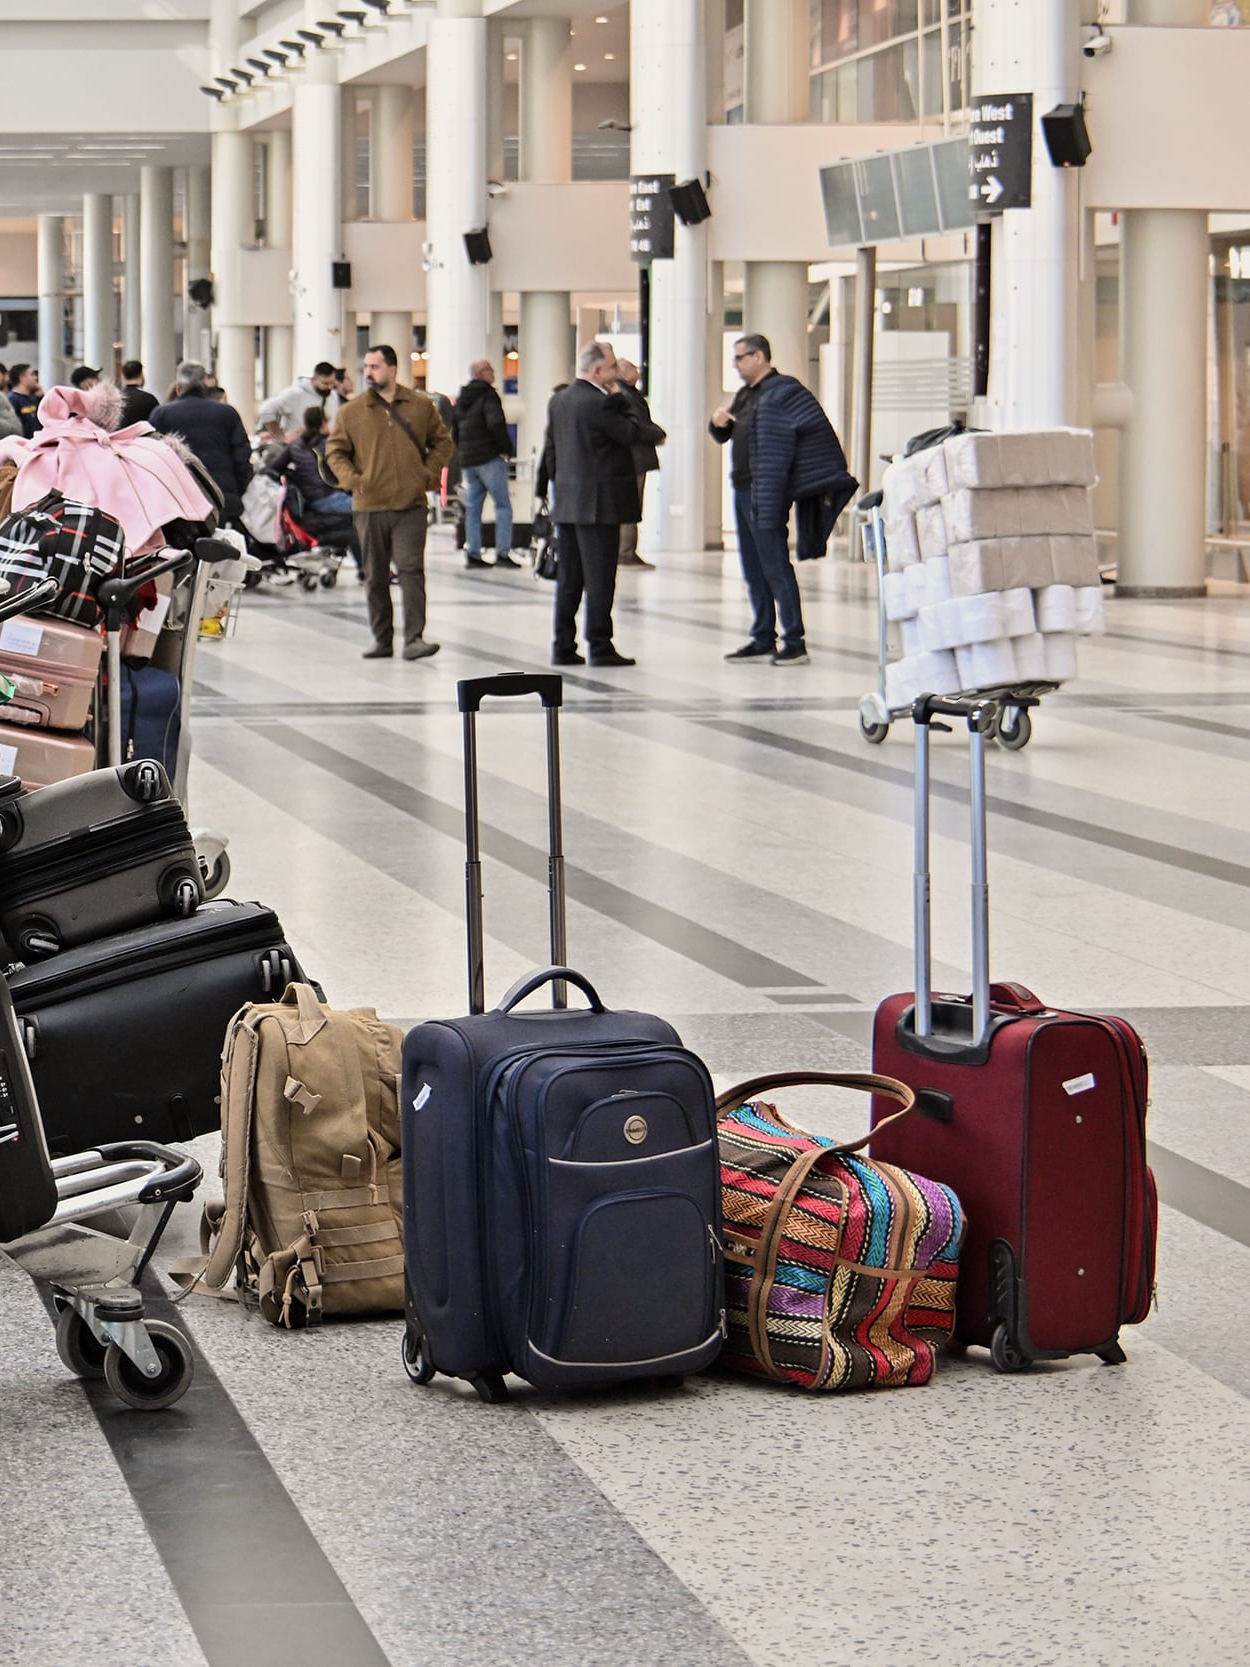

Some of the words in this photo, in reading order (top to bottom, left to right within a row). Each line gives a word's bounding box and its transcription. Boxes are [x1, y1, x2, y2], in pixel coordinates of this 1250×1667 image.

[981, 103, 1014, 121] West
[973, 126, 1005, 145] Ouest
[637, 180, 661, 194] East
[636, 197, 652, 211] Est
